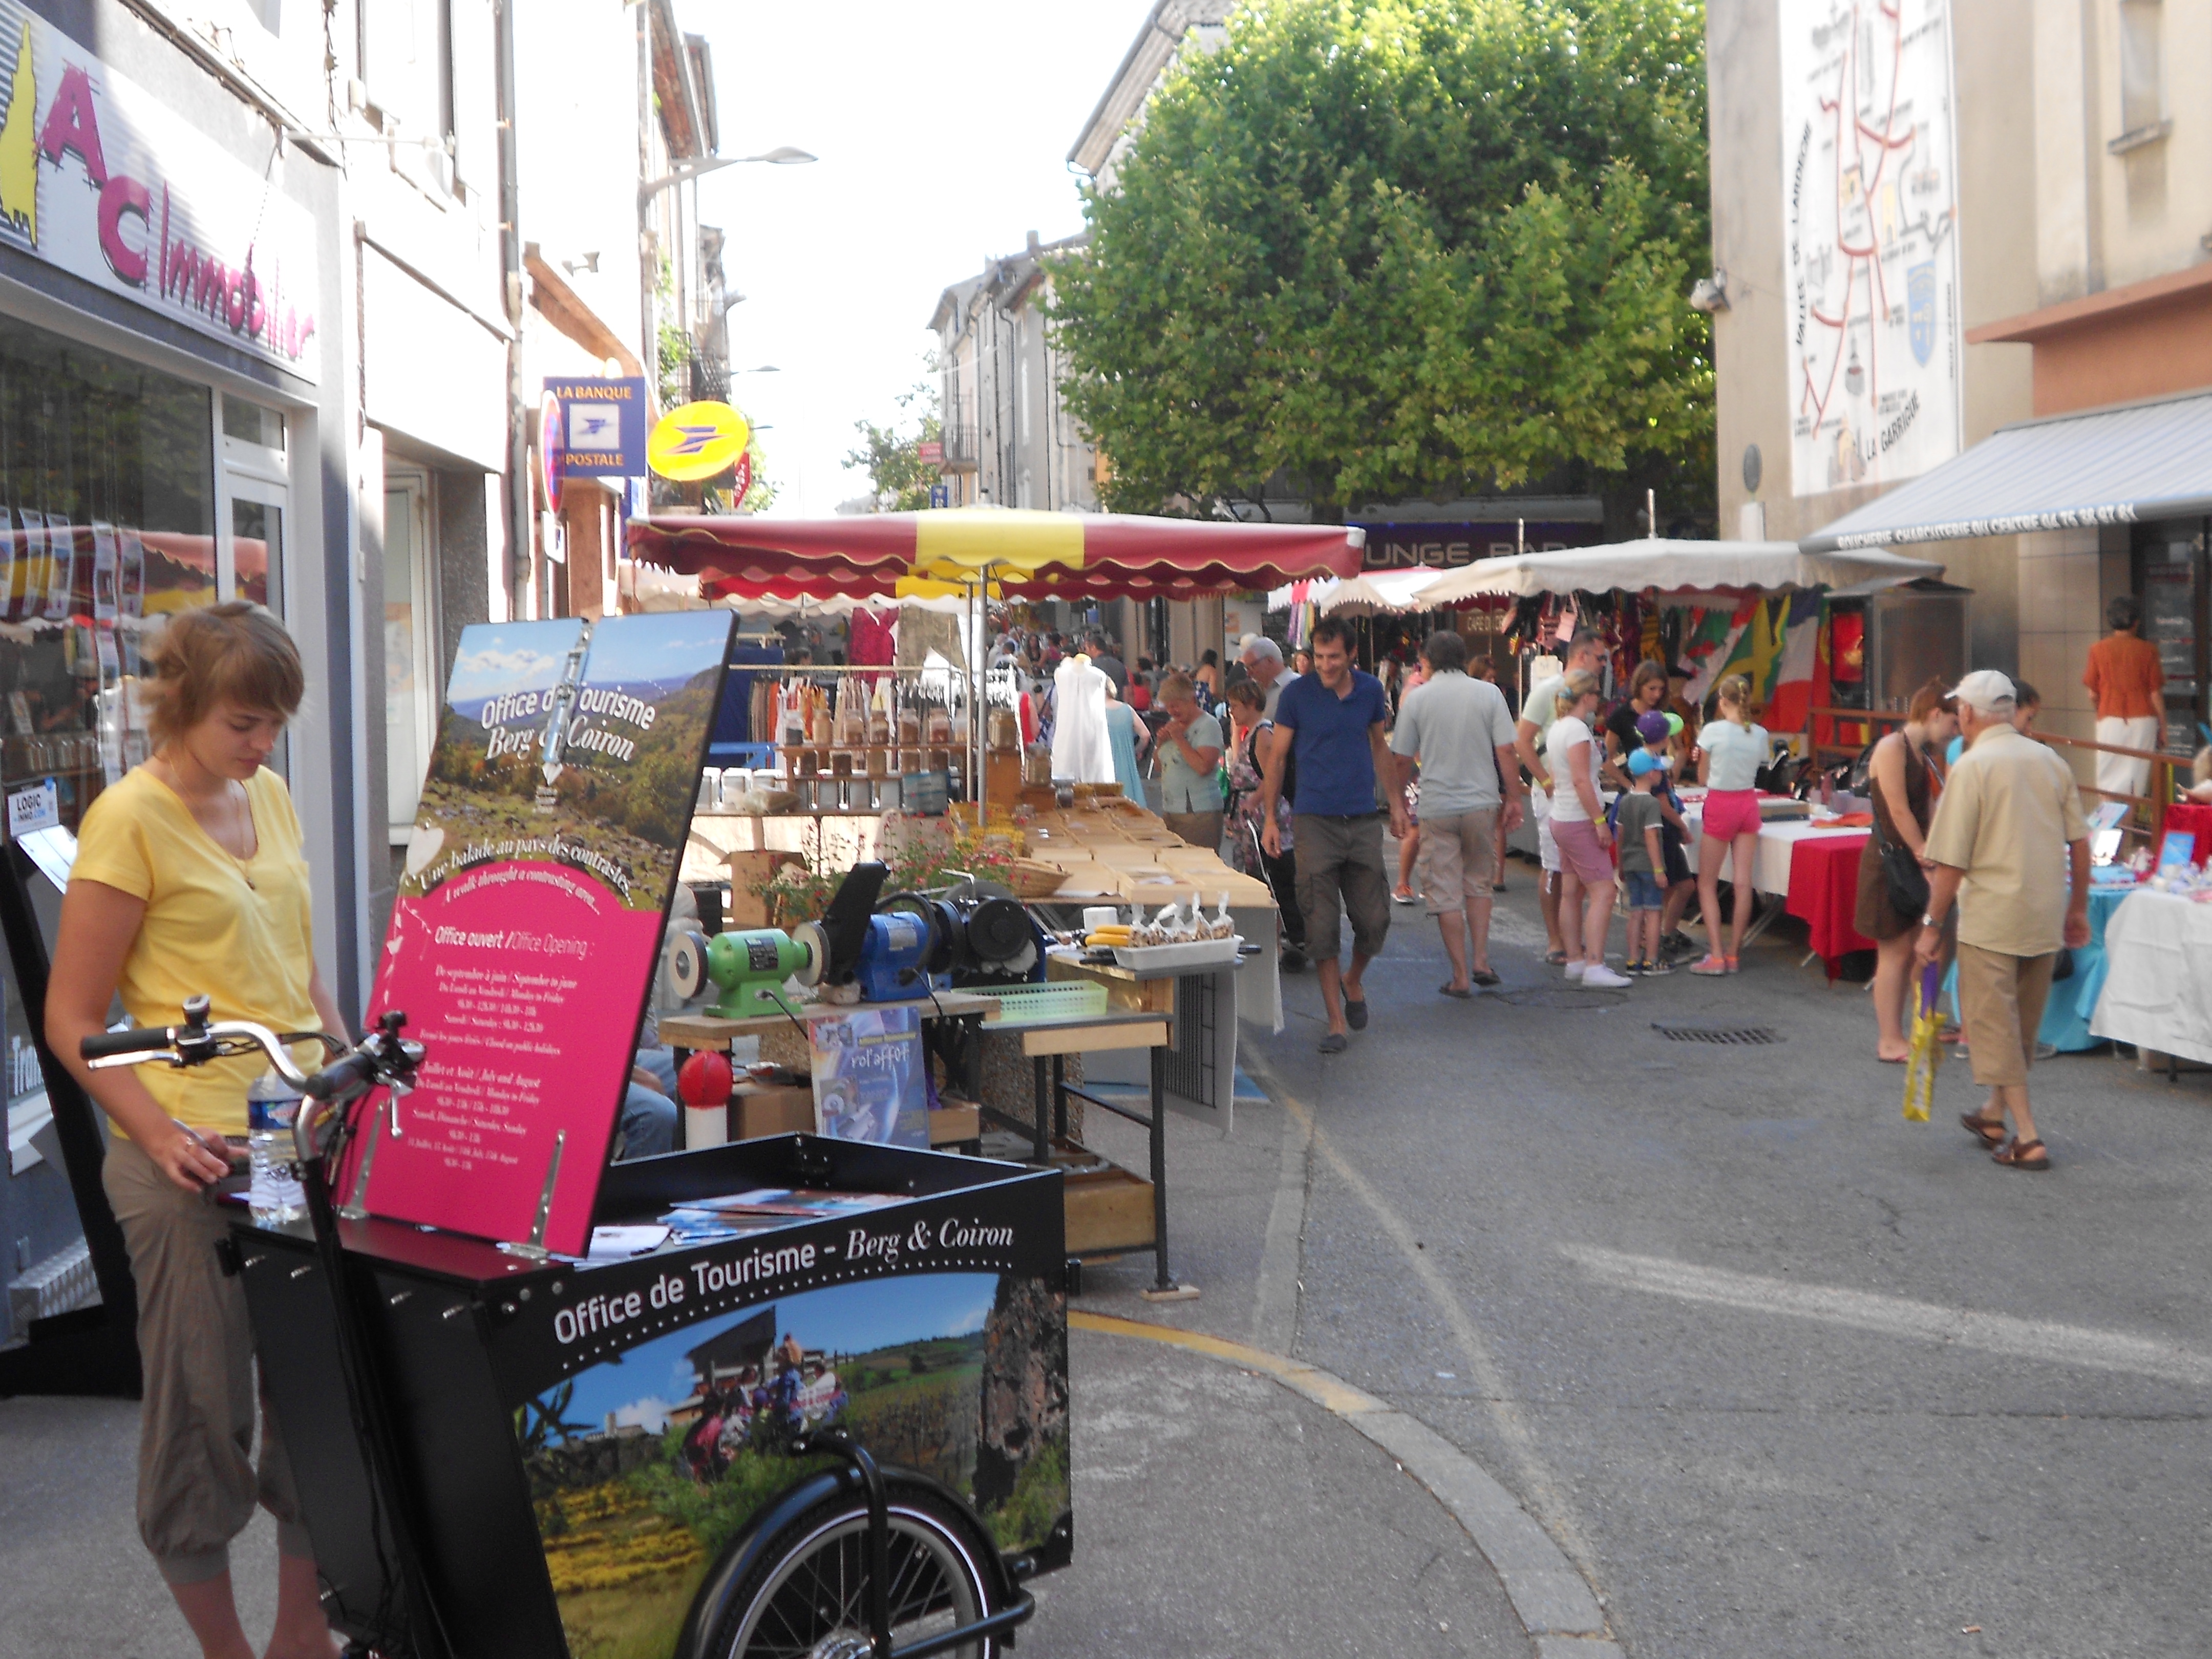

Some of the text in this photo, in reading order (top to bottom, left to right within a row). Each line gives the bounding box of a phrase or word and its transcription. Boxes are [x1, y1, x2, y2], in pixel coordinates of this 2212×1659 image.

[557, 386, 632, 400] LA BANQUE
[565, 454, 624, 466] POSTALE
[1867, 438, 1877, 460] LA
[1366, 543, 1470, 564] UNGE
[481, 691, 538, 730] Office
[579, 682, 656, 730] ourisme
[484, 726, 535, 760] Berg
[567, 715, 635, 762] Coiron
[548, 833, 570, 857] des
[435, 925, 466, 946] Office
[467, 930, 503, 949] ouvert
[543, 933, 587, 961] Opening
[554, 1295, 642, 1345] Office
[649, 1274, 685, 1310] de
[691, 1242, 816, 1296] Tourisme
[845, 1228, 902, 1263] Berg
[906, 1221, 931, 1251] &
[938, 1217, 1014, 1249] Coiron
